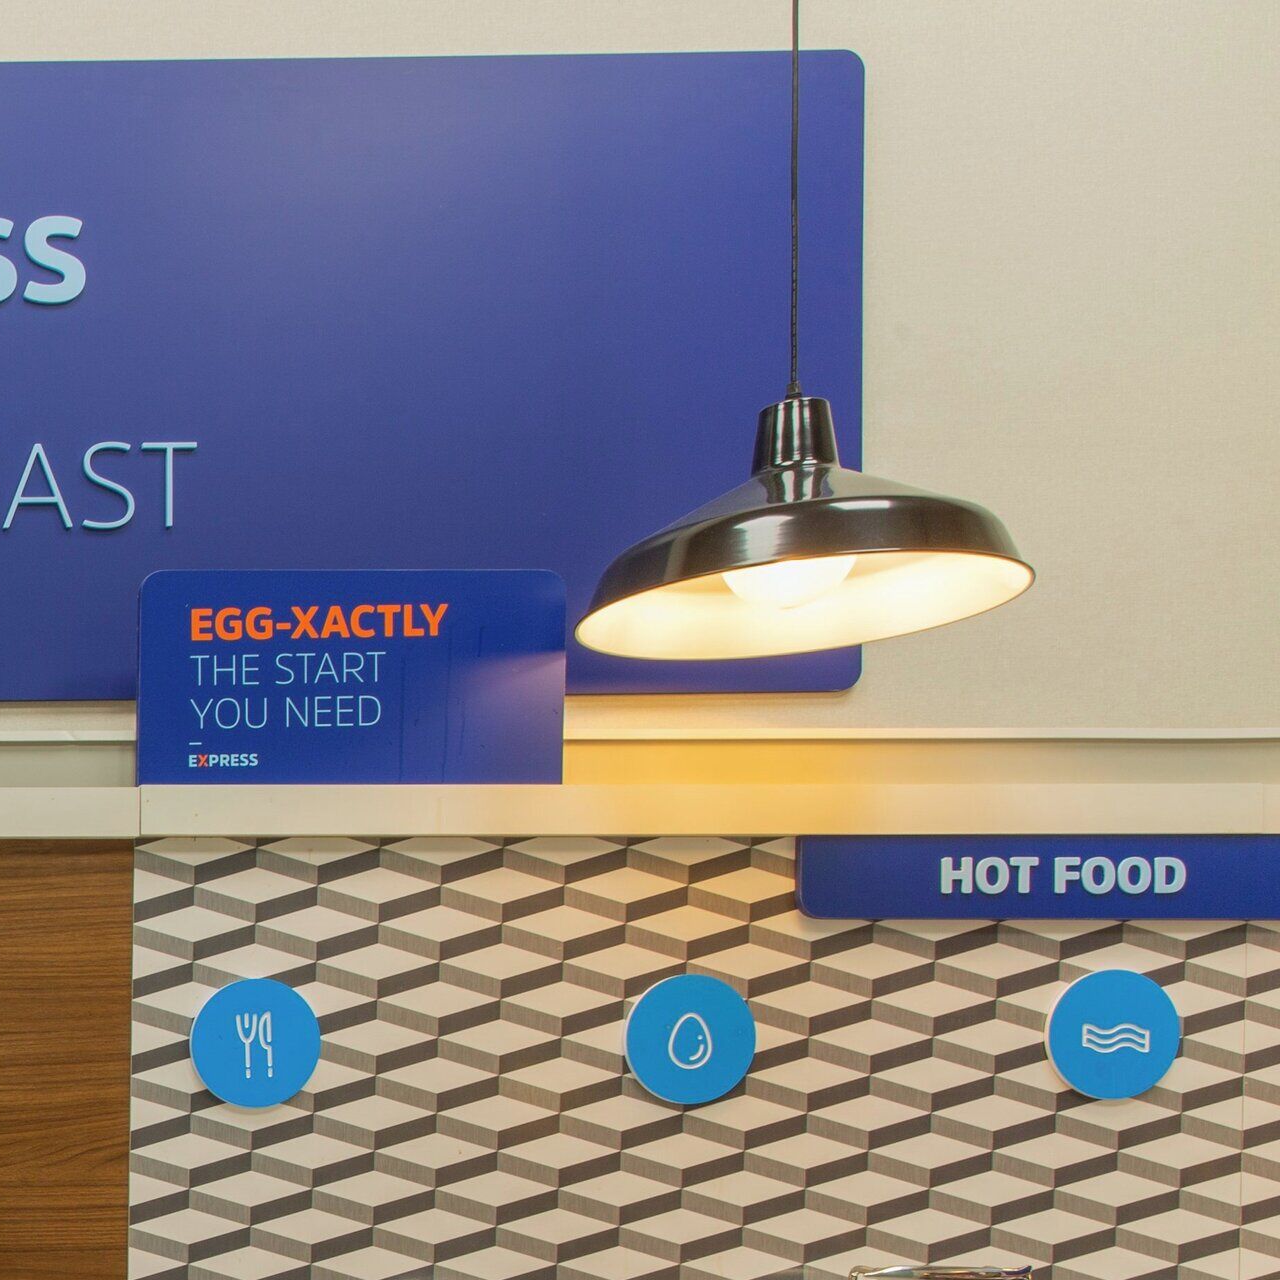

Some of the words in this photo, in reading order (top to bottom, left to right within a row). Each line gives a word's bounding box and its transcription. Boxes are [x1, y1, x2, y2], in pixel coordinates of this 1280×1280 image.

[190, 603, 449, 642] EGG-XACTLY
[190, 653, 260, 687] THE
[274, 651, 387, 685] START
[190, 697, 268, 731] YOU
[285, 695, 382, 729] NEED
[188, 753, 259, 768] EXPRESS
[940, 855, 1040, 895] HOT
[1053, 855, 1188, 895] FOOD
